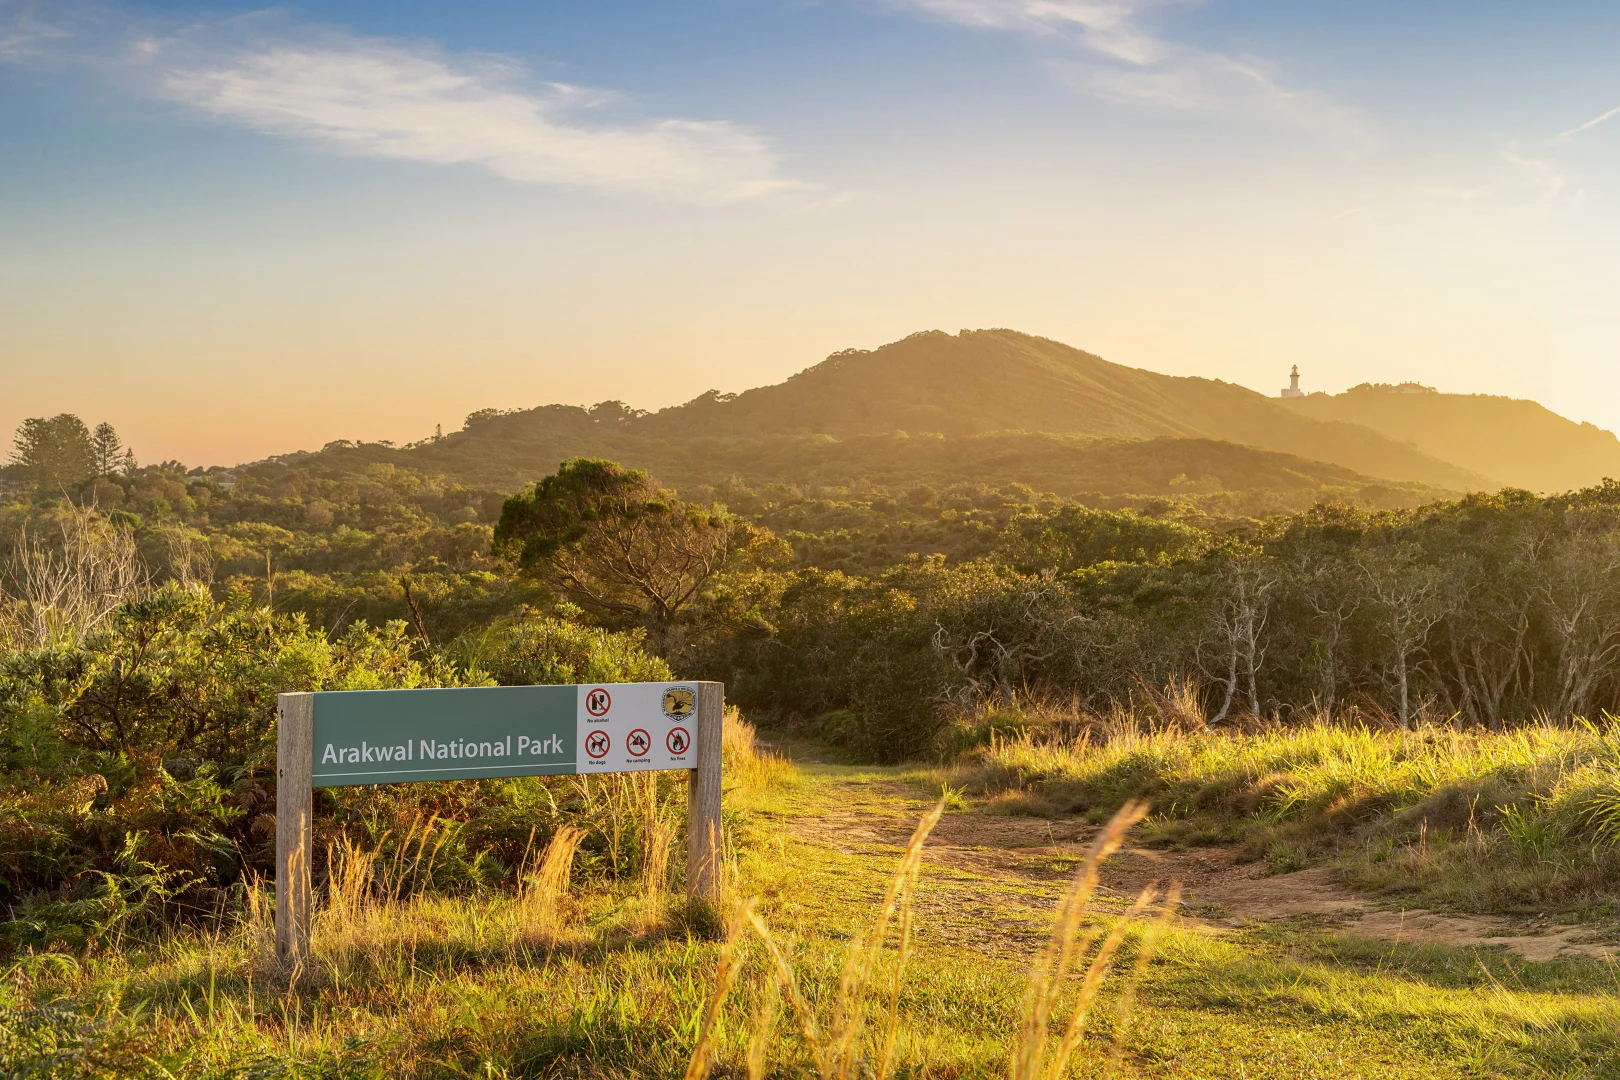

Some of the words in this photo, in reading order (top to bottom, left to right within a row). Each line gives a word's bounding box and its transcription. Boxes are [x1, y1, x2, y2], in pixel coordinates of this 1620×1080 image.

[321, 740, 413, 764] Arakwal
[420, 735, 511, 760] National
[518, 734, 564, 755] Park
